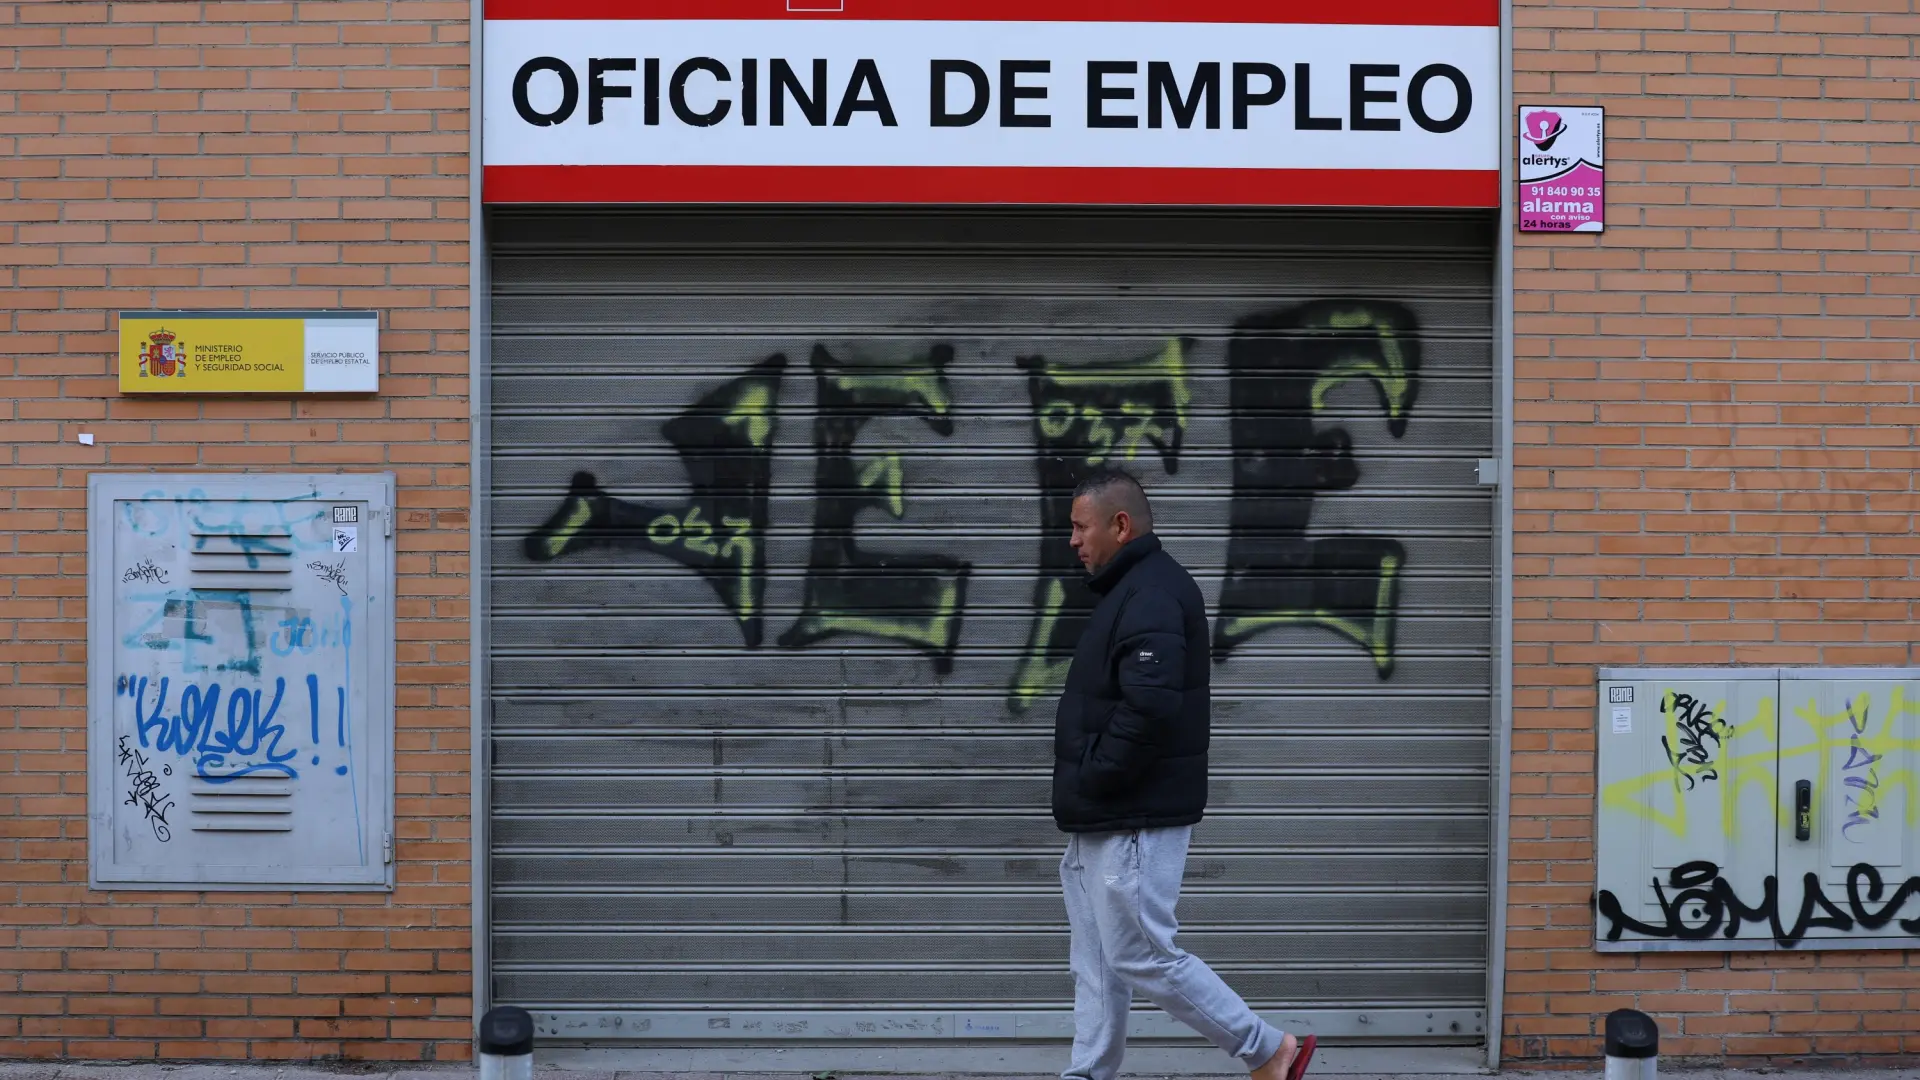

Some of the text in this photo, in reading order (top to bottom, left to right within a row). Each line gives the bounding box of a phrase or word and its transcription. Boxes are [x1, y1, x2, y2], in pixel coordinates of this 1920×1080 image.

[513, 56, 1472, 133] OFICINA DE EMPLEO
[1522, 154, 1568, 168] alertys
[1531, 186, 1601, 197] 91 840 90 35
[1522, 197, 1594, 213] alarma
[1523, 219, 1571, 229] 24 horas
[194, 344, 243, 353] MINISTERIO
[194, 354, 242, 362] DE EMPLEO
[194, 363, 285, 371] Y SEGURIDAD SOCIAL
